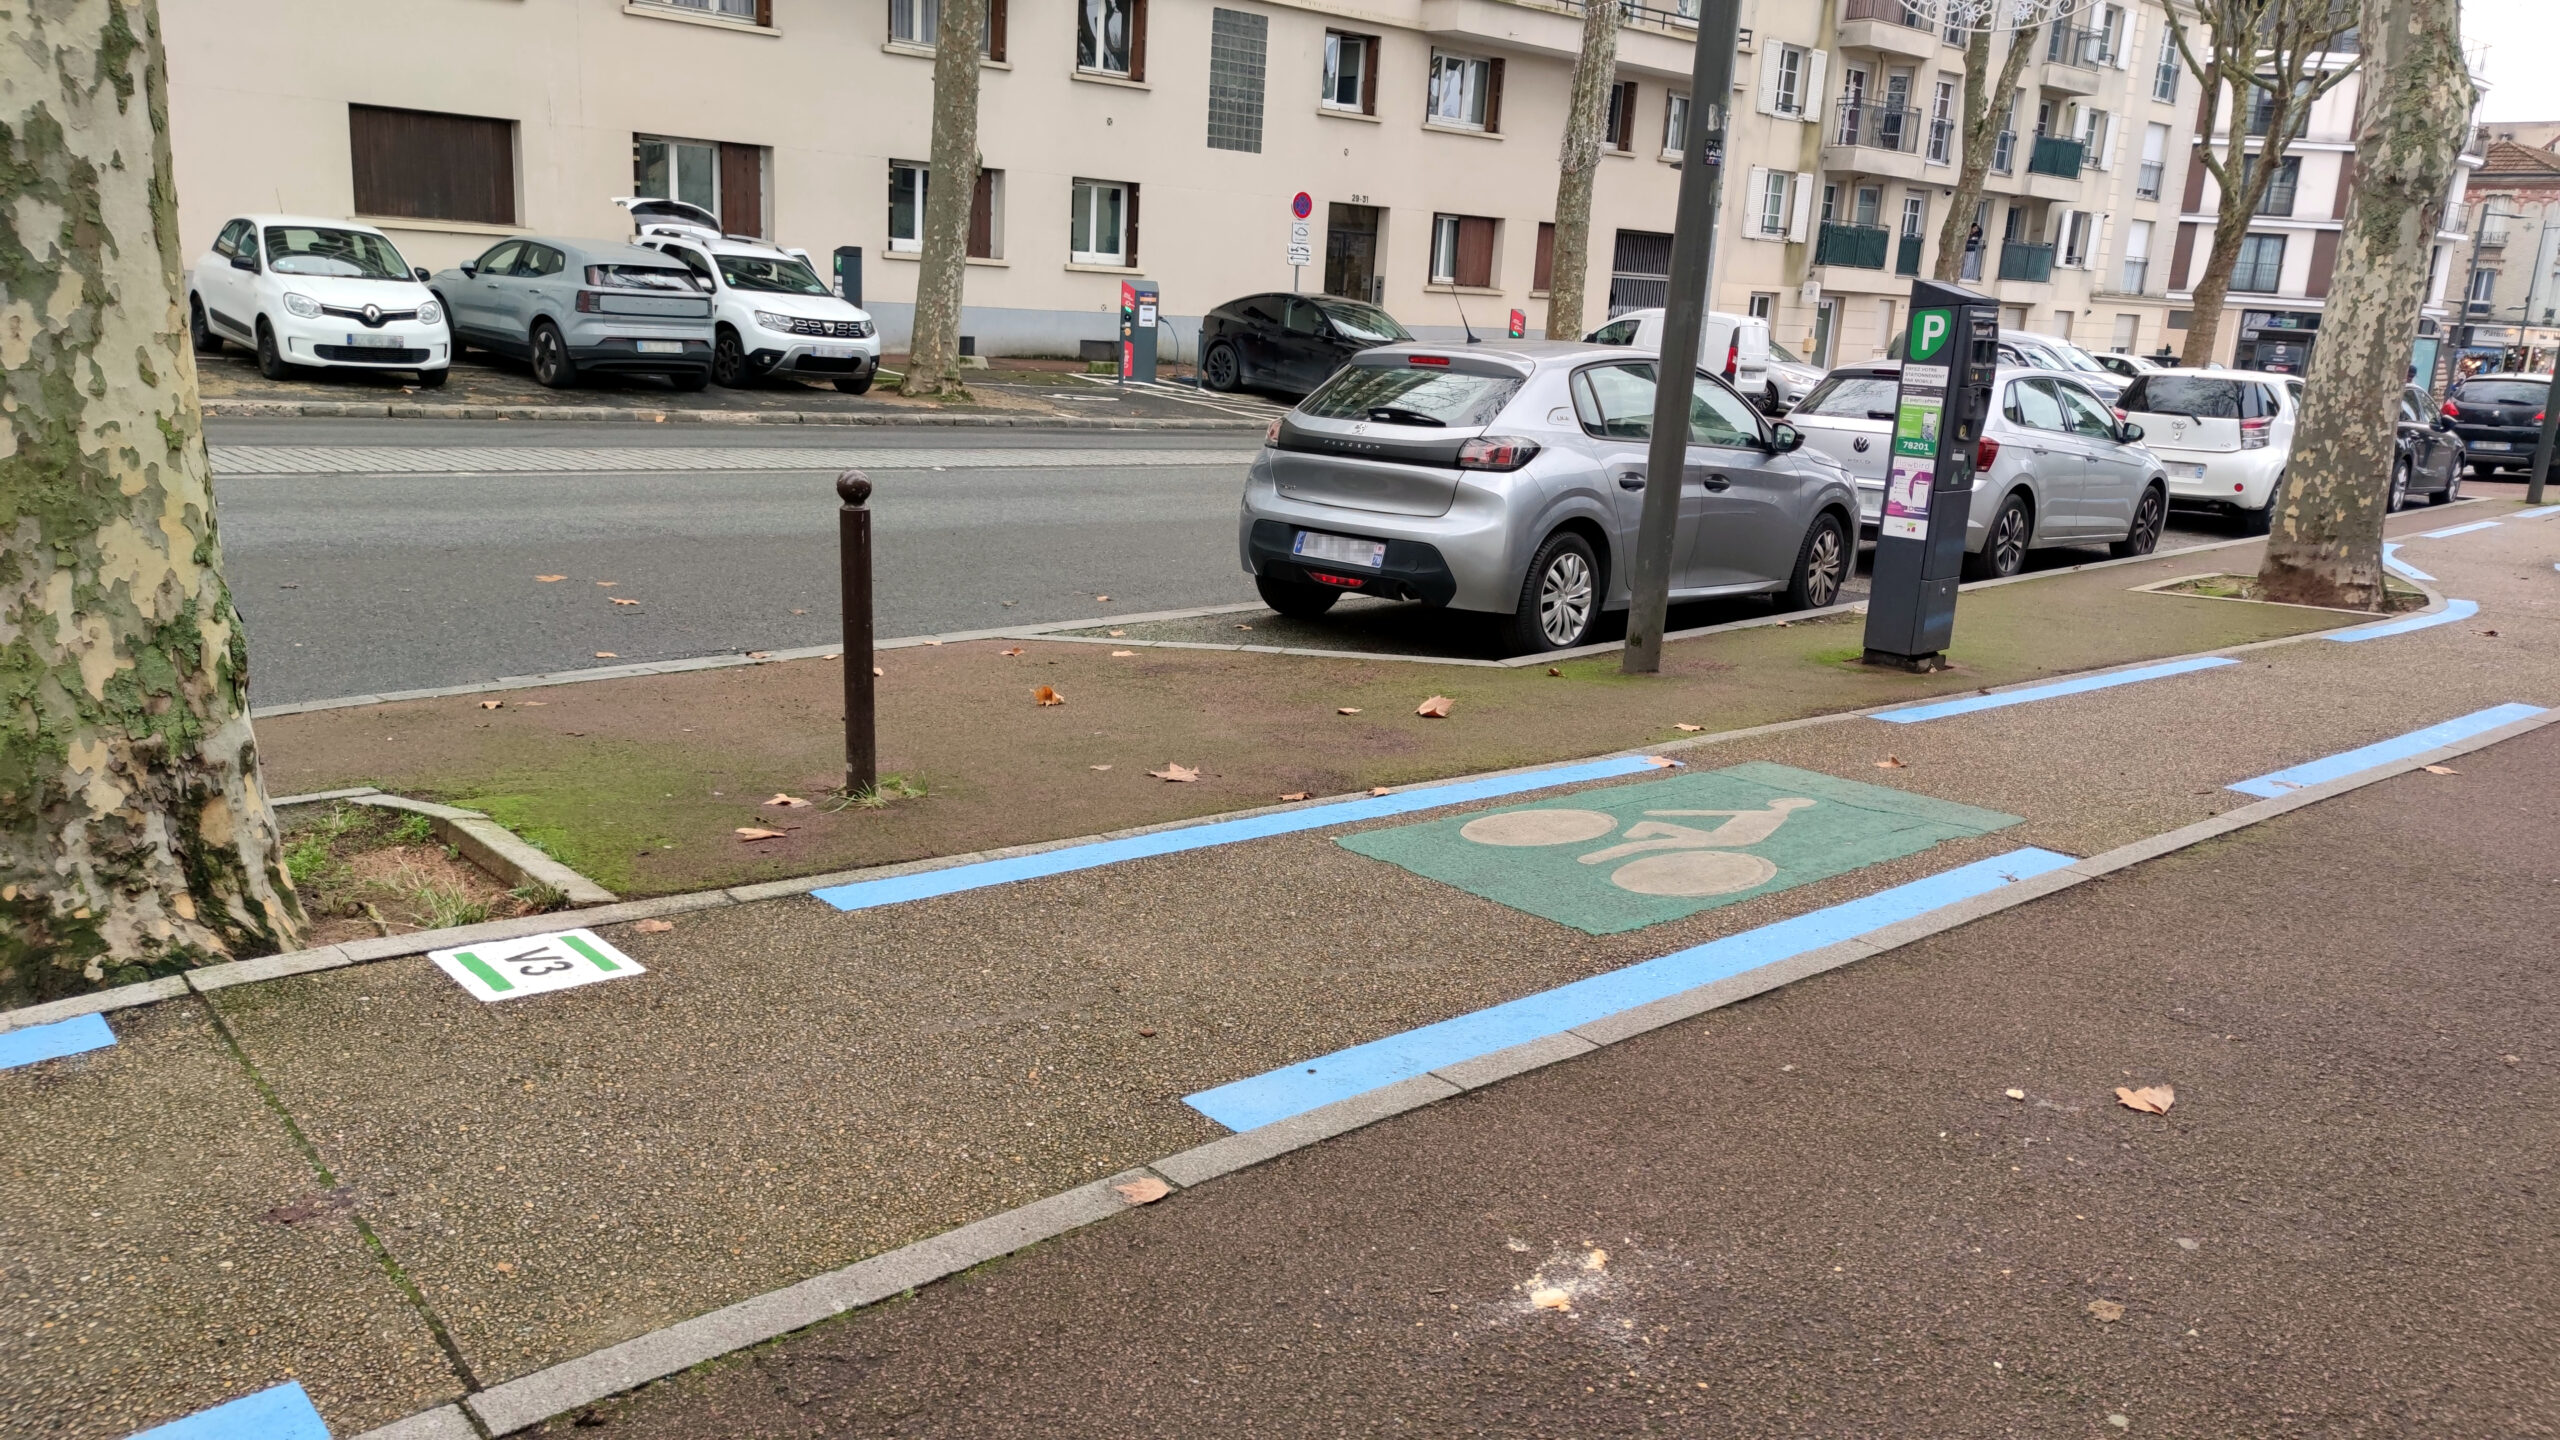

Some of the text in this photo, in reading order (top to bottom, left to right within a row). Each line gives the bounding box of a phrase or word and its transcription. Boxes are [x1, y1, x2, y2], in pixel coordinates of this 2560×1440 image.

[1351, 194, 1369, 203] 29-31
[1922, 315, 1945, 351] P
[1324, 439, 1380, 449] PEUGEOT
[1903, 441, 1929, 451] 78201
[1896, 458, 1930, 470] flowbird
[504, 946, 574, 976] V3
